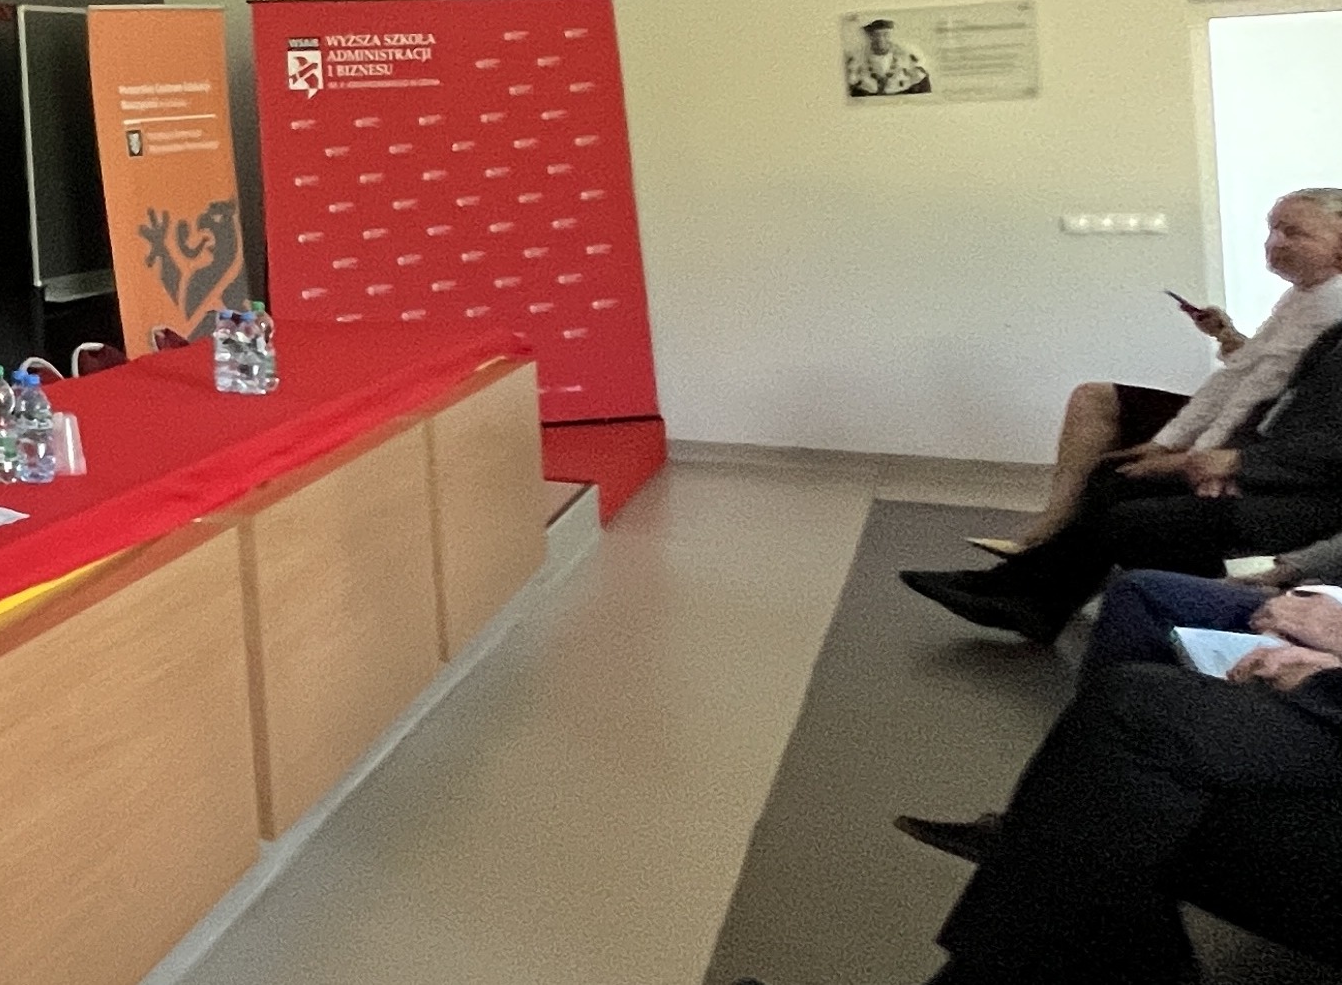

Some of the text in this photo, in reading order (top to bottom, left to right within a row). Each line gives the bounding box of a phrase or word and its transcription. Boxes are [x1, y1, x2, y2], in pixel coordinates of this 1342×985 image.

[325, 32, 437, 47] WYŻSZA SZKOŁA
[326, 47, 433, 63] ADMINISTRACJI
[336, 63, 394, 77] BIZNESU
